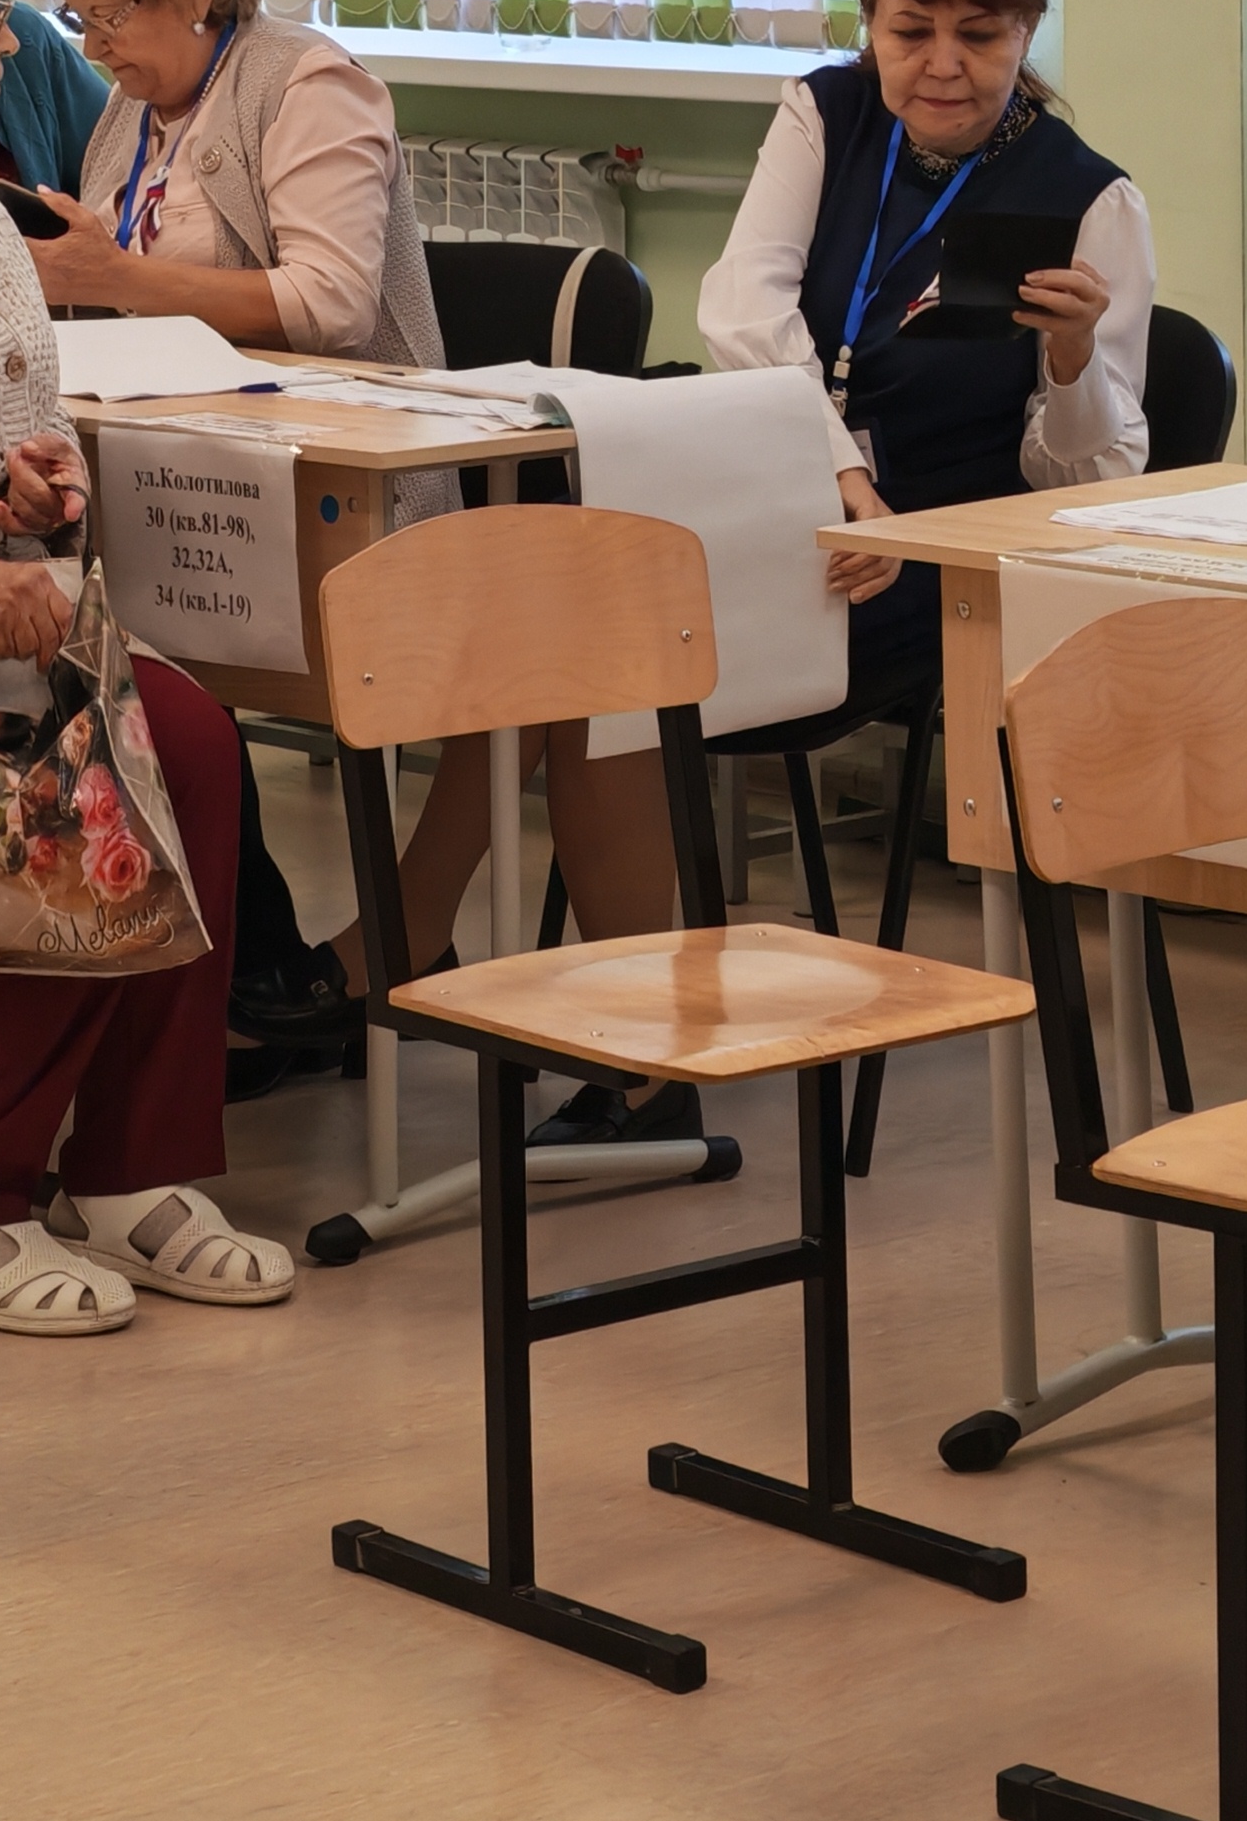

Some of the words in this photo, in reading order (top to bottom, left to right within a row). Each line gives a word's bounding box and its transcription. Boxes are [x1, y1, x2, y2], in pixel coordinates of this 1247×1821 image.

[134, 466, 260, 500] ул.Колотилова
[146, 505, 165, 528] 30
[169, 508, 256, 545] (кв.81-98),
[172, 546, 233, 579] 32,32А,
[155, 584, 174, 607] 34
[179, 587, 252, 624] (кв.1-19)
